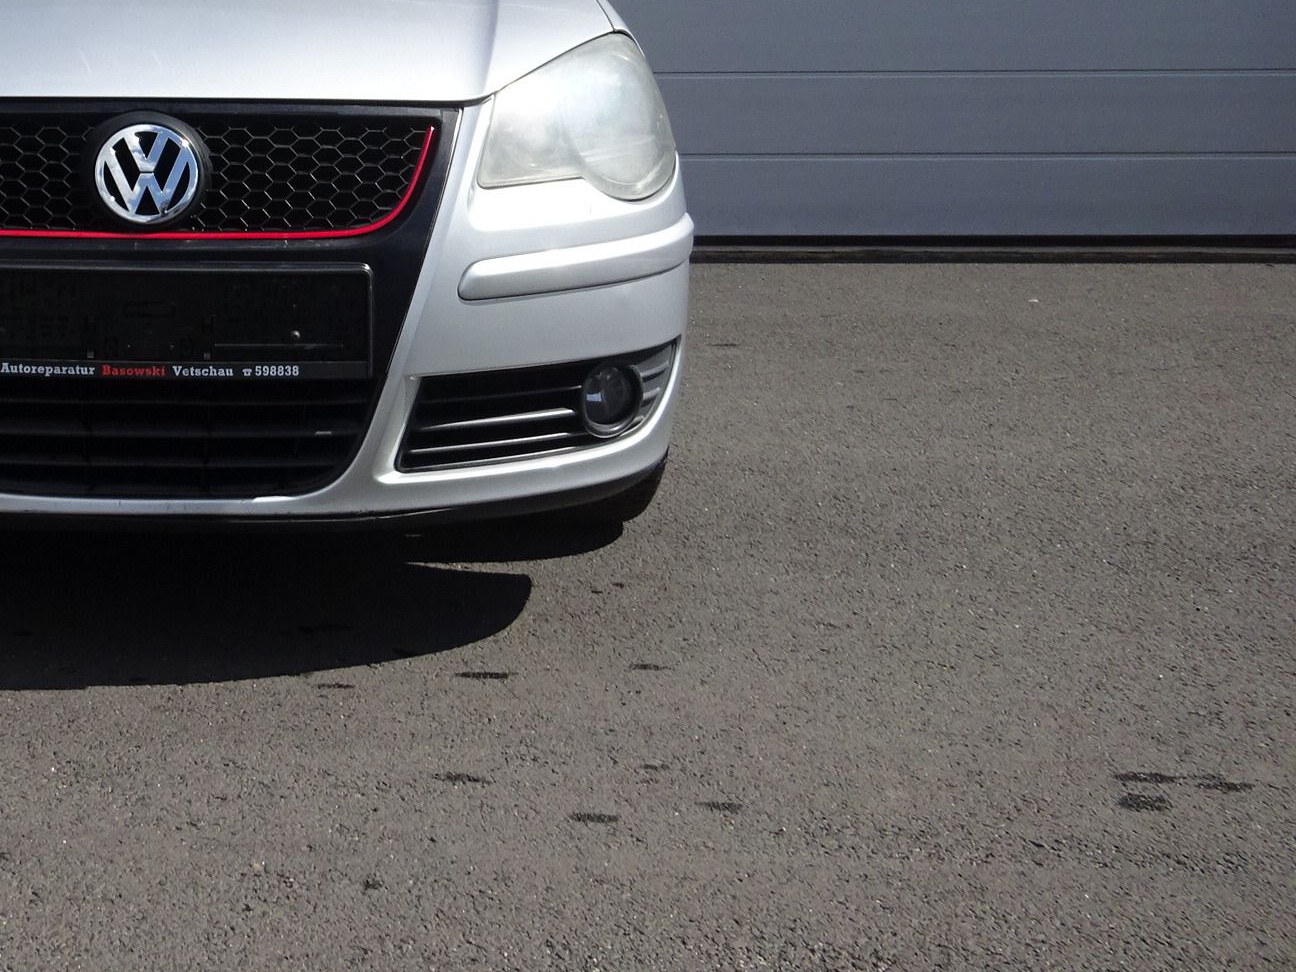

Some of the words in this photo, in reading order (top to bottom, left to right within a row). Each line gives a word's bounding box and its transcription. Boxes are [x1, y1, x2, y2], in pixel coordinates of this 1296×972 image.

[98, 126, 197, 222] VW
[0, 362, 95, 377] Autoreparatur
[102, 364, 165, 377] Basowski
[172, 365, 234, 377] Vetschau
[254, 364, 300, 377] 598838
